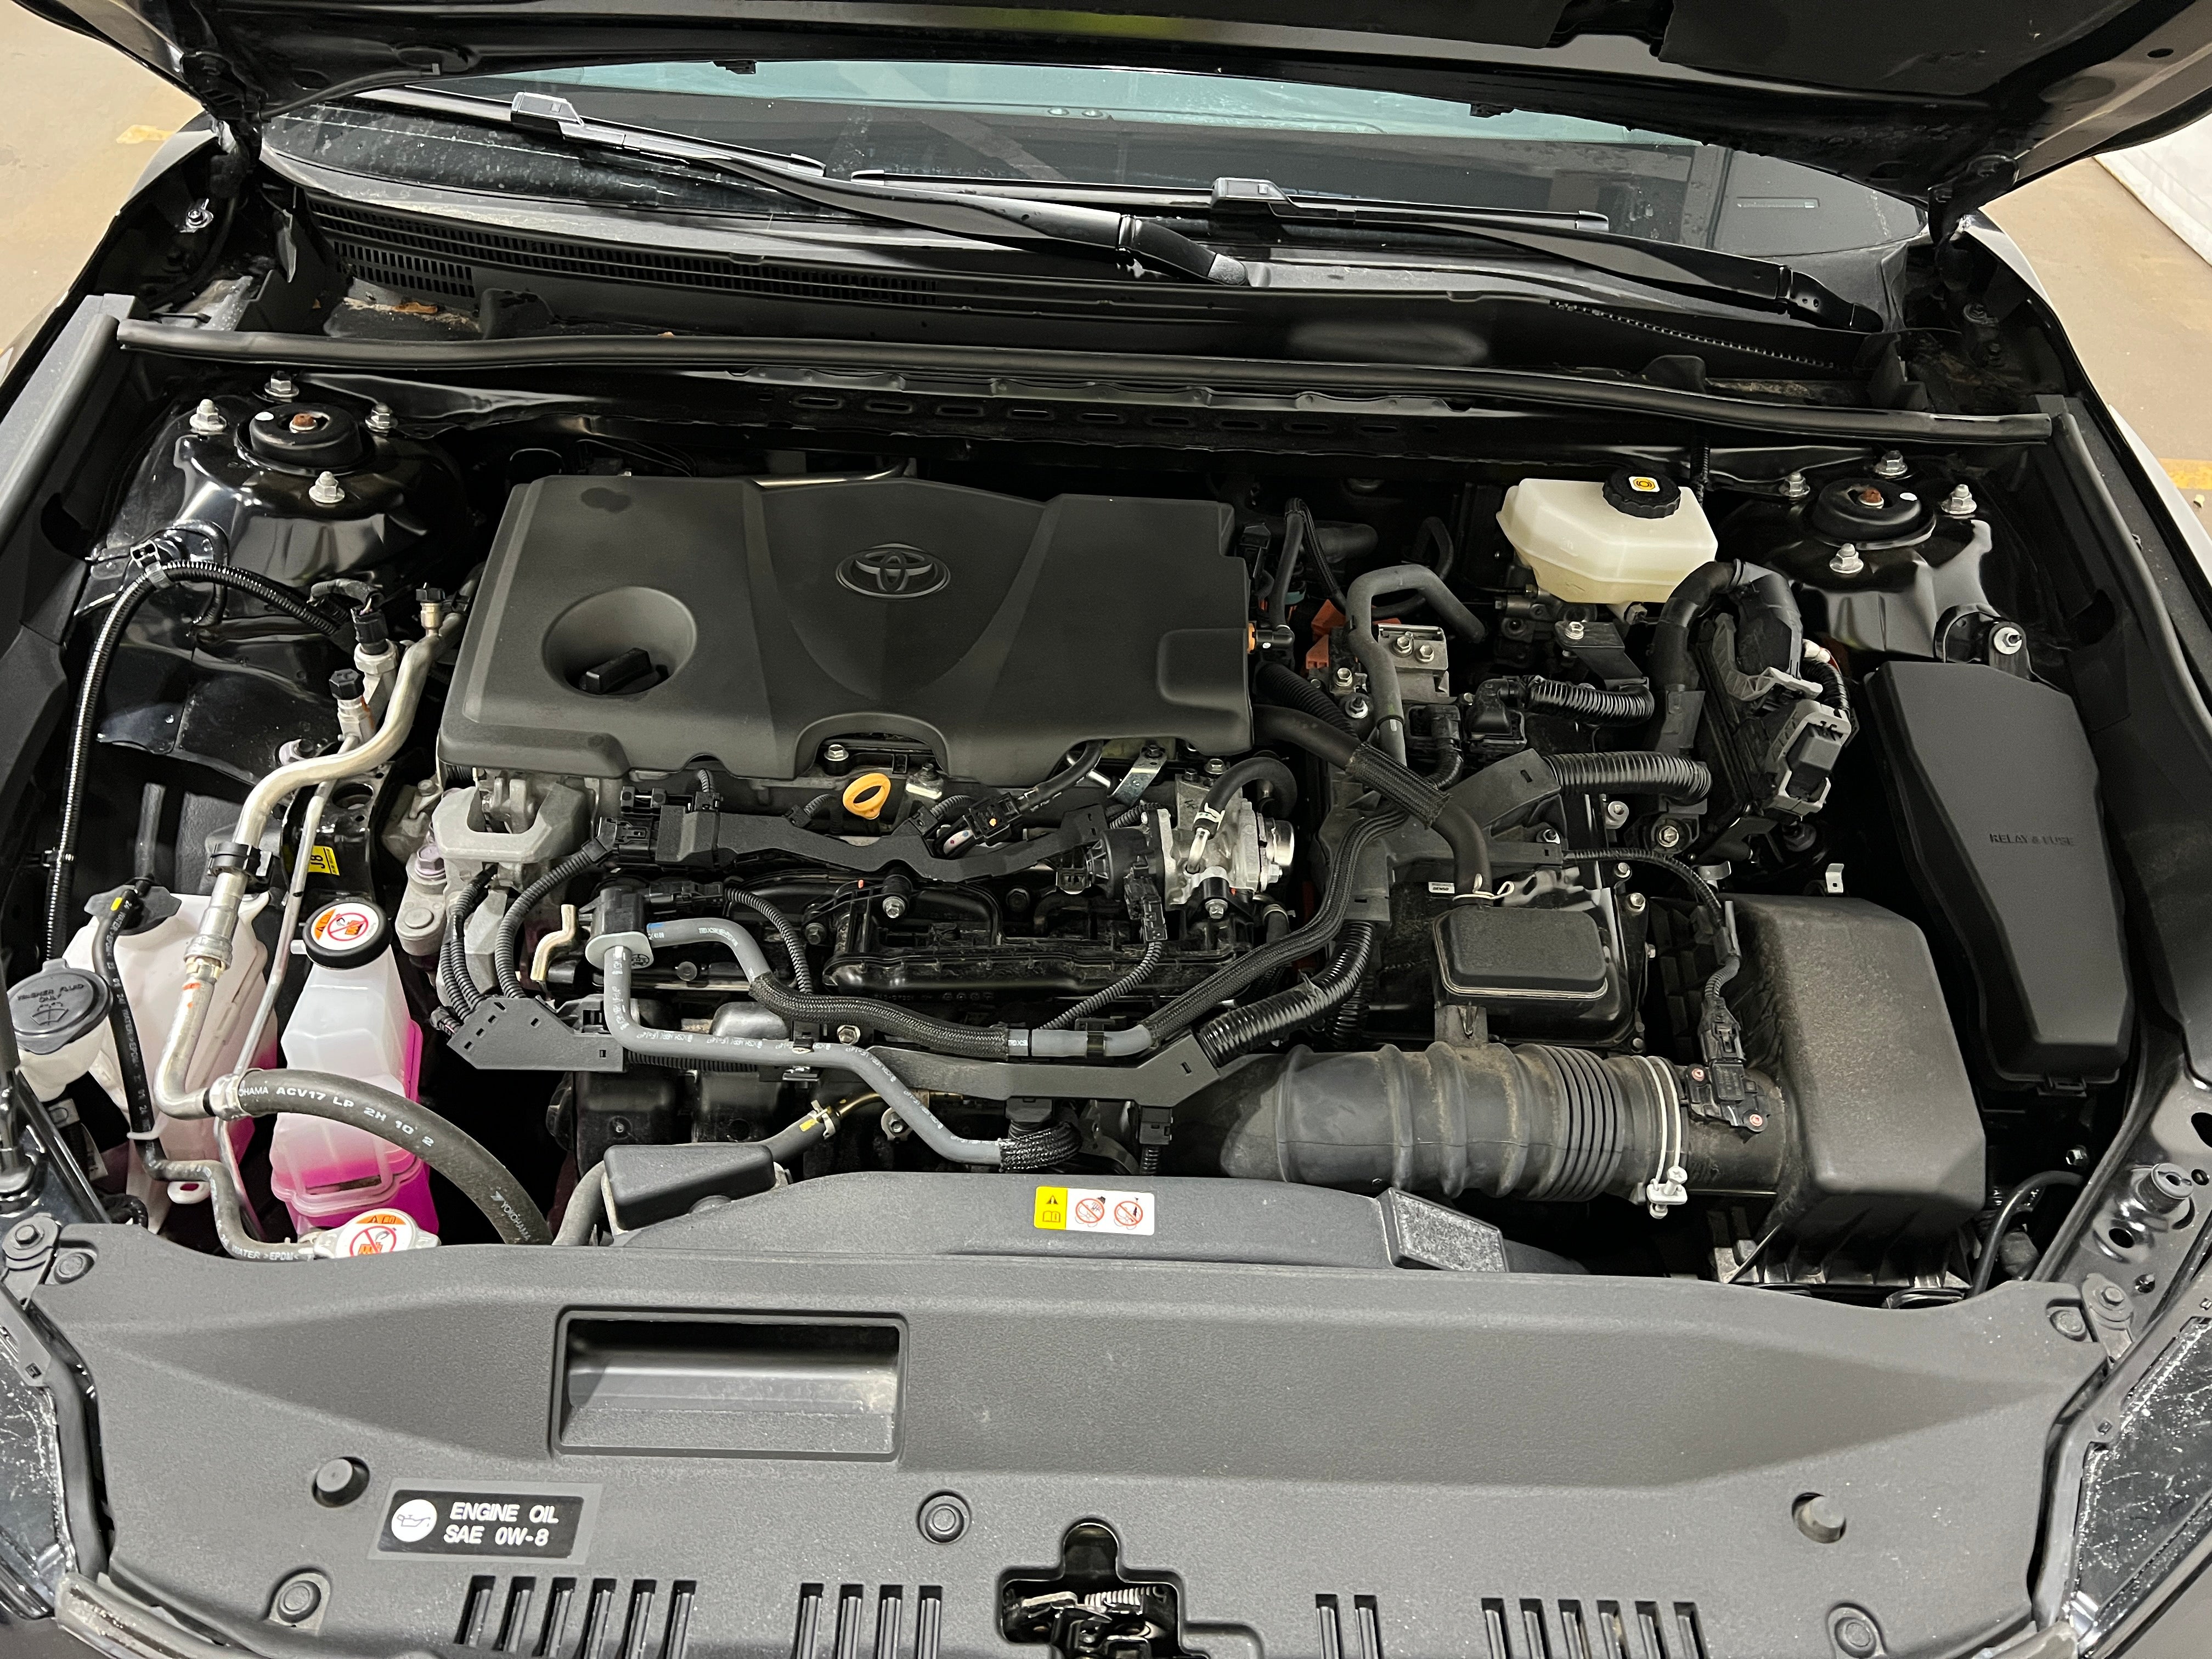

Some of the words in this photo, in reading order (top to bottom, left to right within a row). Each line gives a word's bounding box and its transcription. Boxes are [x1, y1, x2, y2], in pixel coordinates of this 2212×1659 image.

[1989, 833, 2028, 843] RELAY
[276, 1086, 326, 1101] ACV17
[332, 1096, 354, 1108] LP
[363, 1107, 387, 1121] 2H
[395, 1120, 414, 1135] 10
[500, 1200, 531, 1242] YOKOHAMA
[232, 1245, 261, 1260] WATER
[449, 1502, 520, 1522] ENGINE
[529, 1505, 559, 1524] OIL
[443, 1524, 485, 1544] SAE
[495, 1527, 550, 1547] 0W-8
